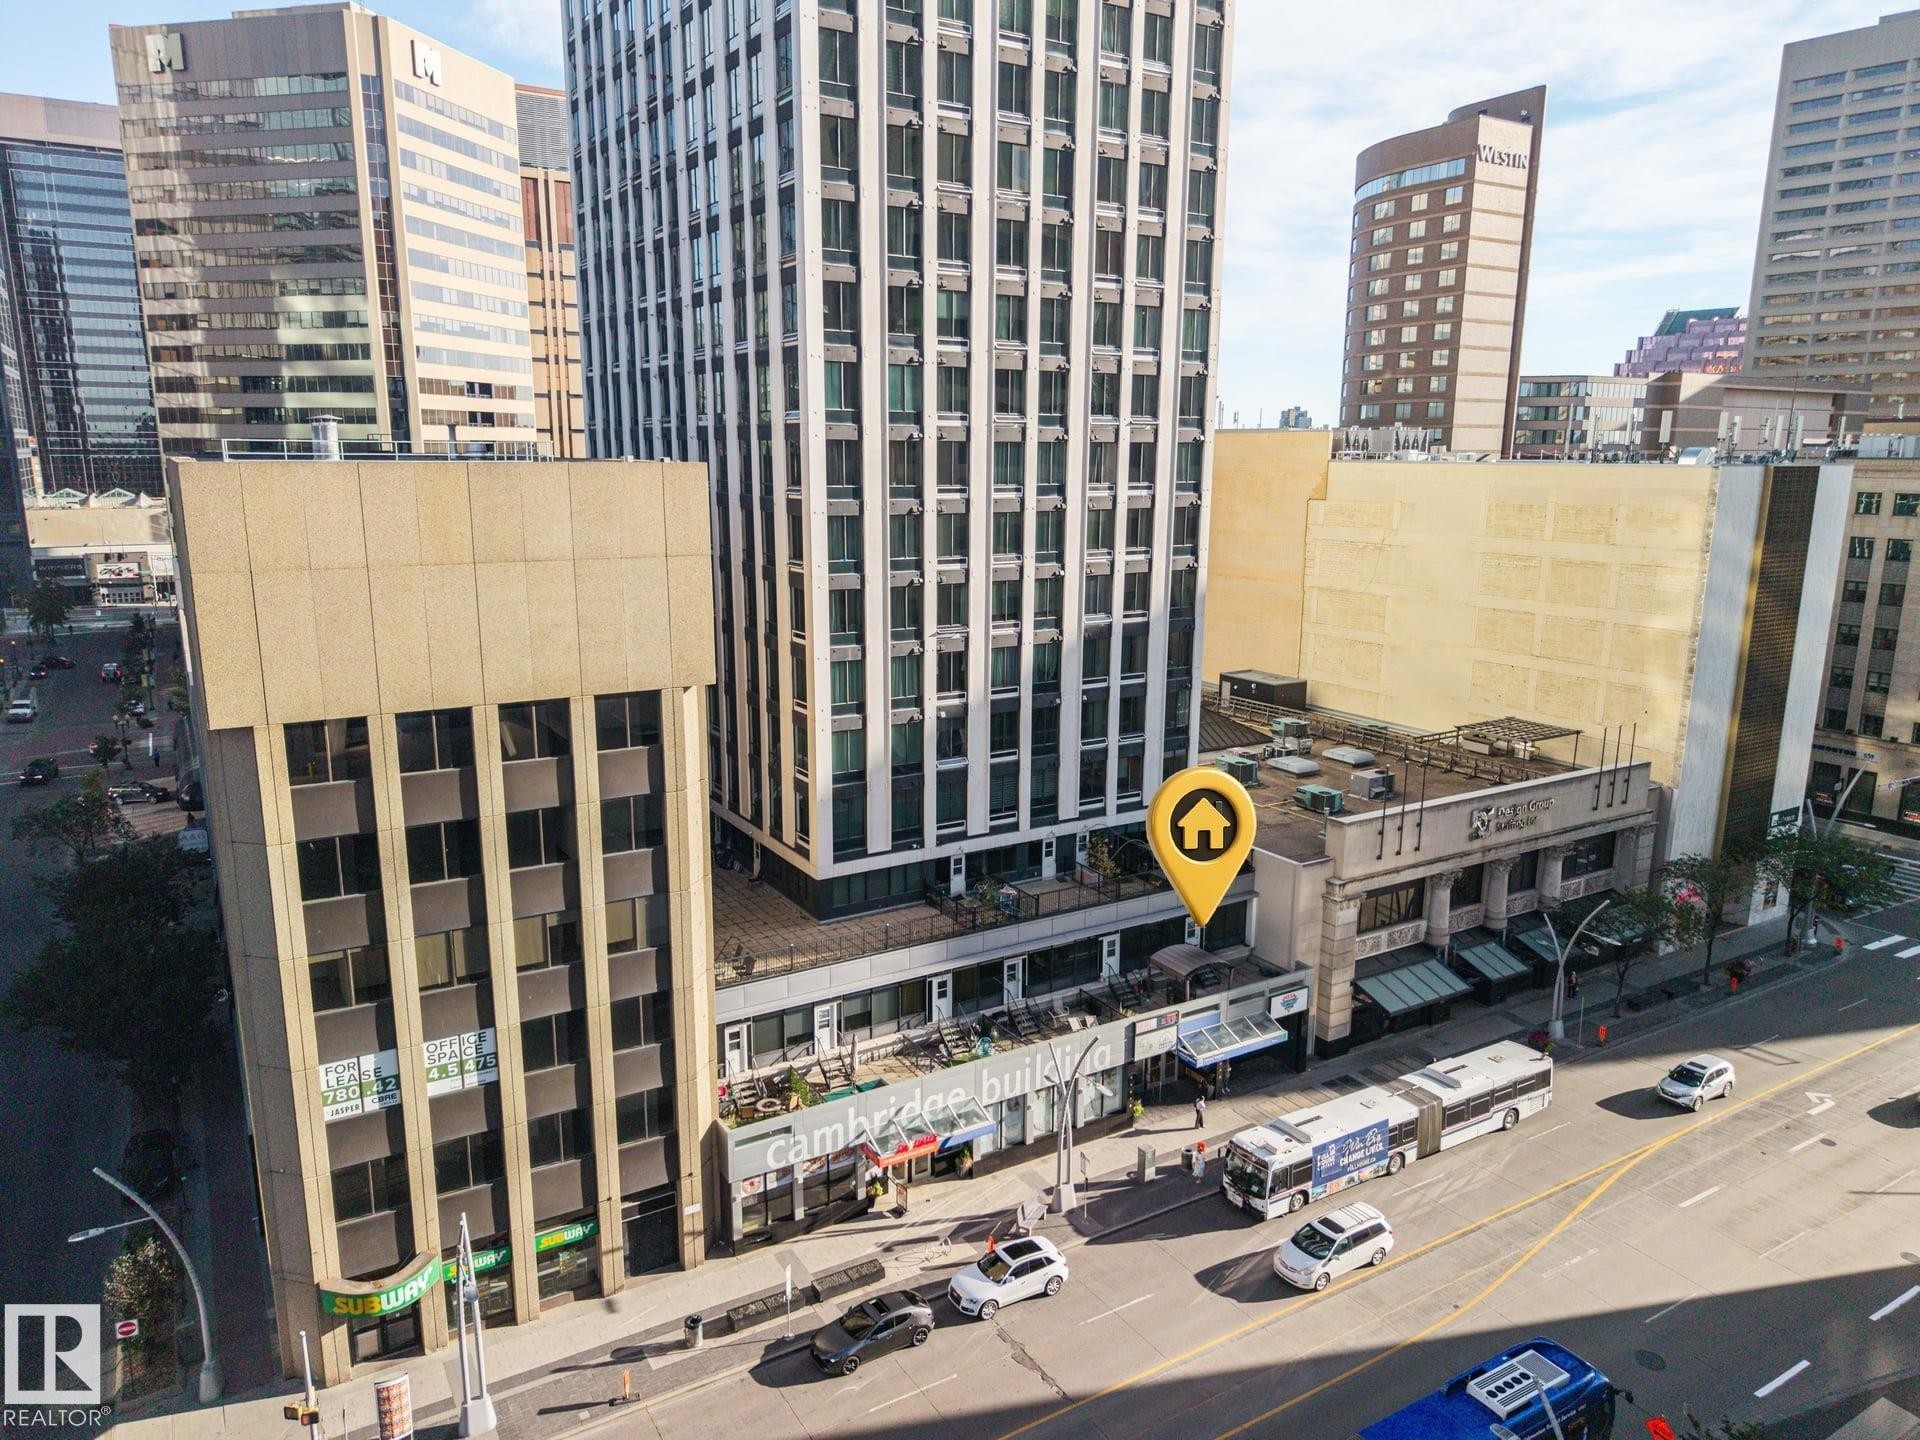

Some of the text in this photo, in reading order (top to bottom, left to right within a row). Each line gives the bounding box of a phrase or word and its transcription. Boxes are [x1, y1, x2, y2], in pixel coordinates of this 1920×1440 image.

[1476, 143, 1528, 169] WESTIN
[1498, 798, 1555, 817] Design Group
[426, 1031, 487, 1054] OFFICE
[427, 1043, 484, 1066] SPACE
[325, 1061, 356, 1078] FOR
[326, 1066, 382, 1089] LEASE
[371, 1092, 397, 1104] CBRE
[330, 1103, 360, 1117] JASPER
[766, 1086, 966, 1170] cambridge
[1339, 1149, 1365, 1167] CHANGE
[539, 1222, 594, 1248] SUBWAY
[448, 1249, 506, 1277] SWAY
[333, 1265, 433, 1315] SUBWAY
